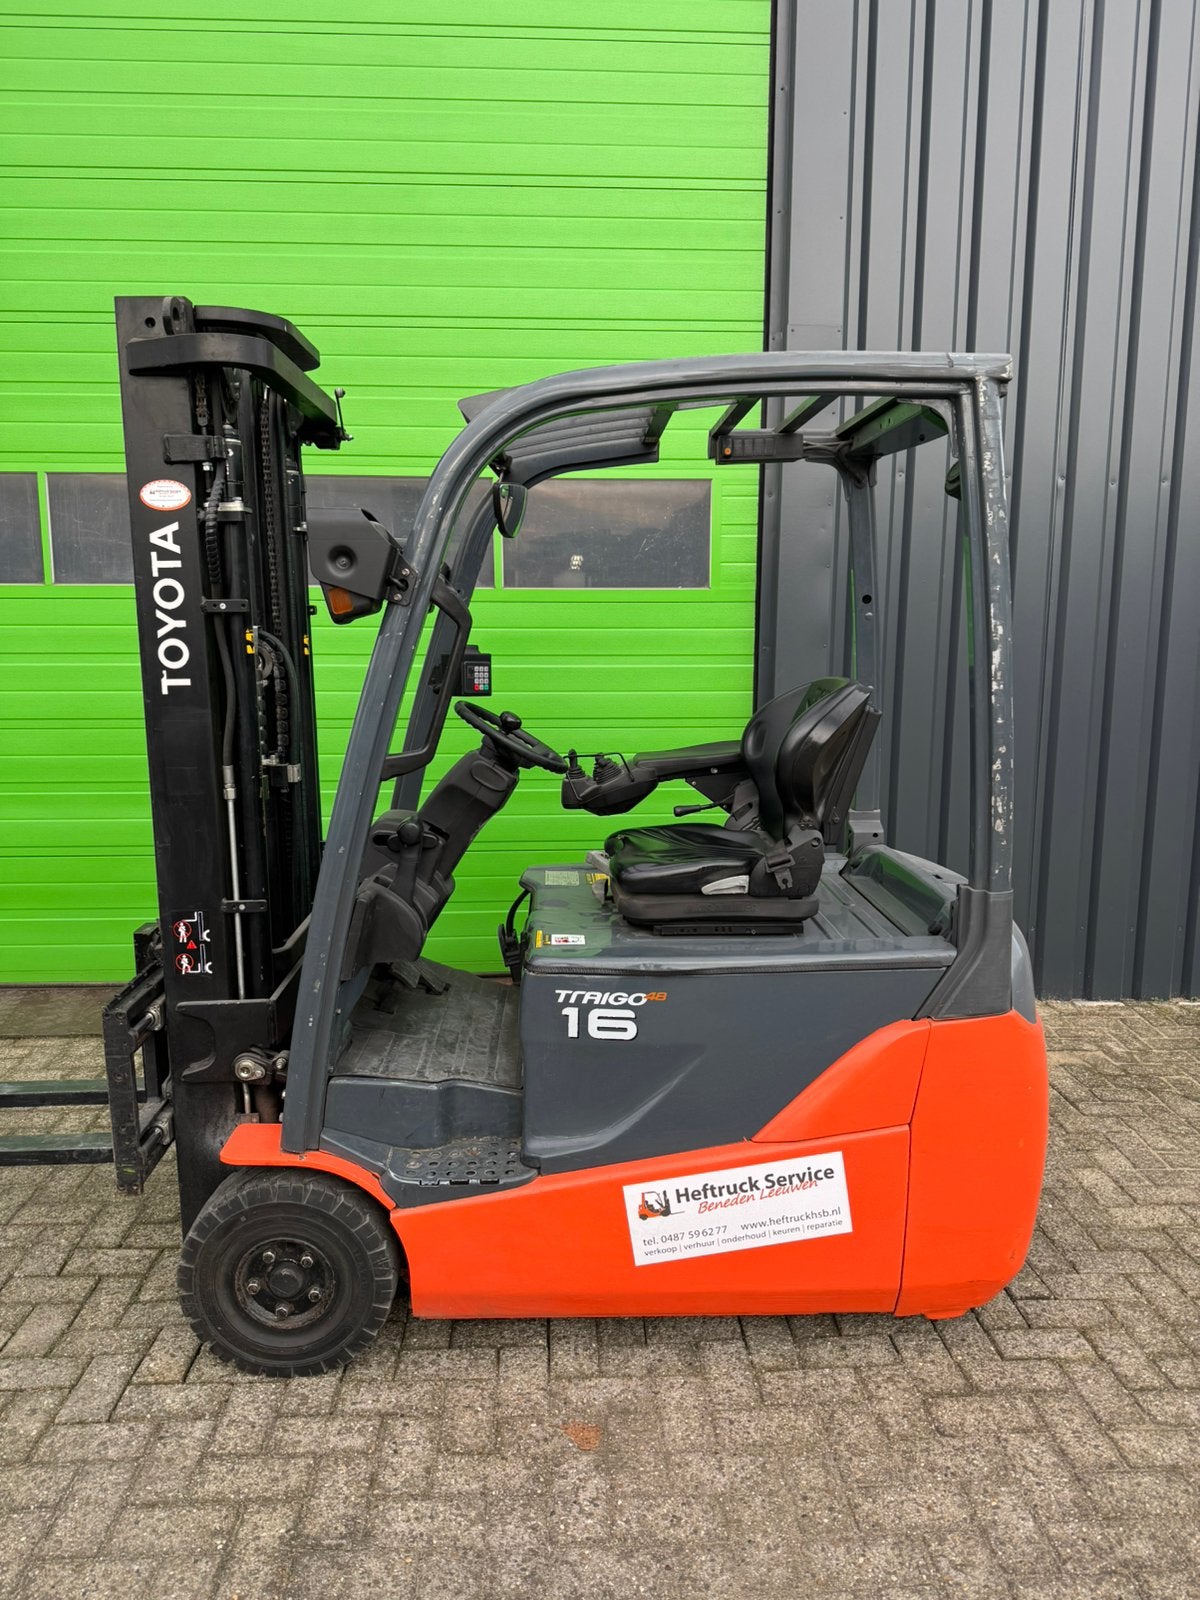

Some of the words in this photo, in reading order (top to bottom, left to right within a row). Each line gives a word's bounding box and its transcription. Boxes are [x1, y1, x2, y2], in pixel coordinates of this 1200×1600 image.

[149, 521, 192, 695] TOYOTA
[561, 1007, 638, 1040] 16
[675, 1176, 761, 1204] Heftruck
[764, 1166, 835, 1190] Service
[697, 1192, 755, 1214] Beneden
[759, 1179, 818, 1200] Leeuwen
[643, 1236, 659, 1246] tel.
[660, 1231, 685, 1244] 0487
[740, 1206, 841, 1231] www.heftruckhsb.nl
[644, 1245, 677, 1256] verkoop
[683, 1239, 715, 1251] verhuur
[721, 1231, 767, 1245] onderhoud
[772, 1225, 801, 1236] keuren
[806, 1219, 843, 1232] reparatie
